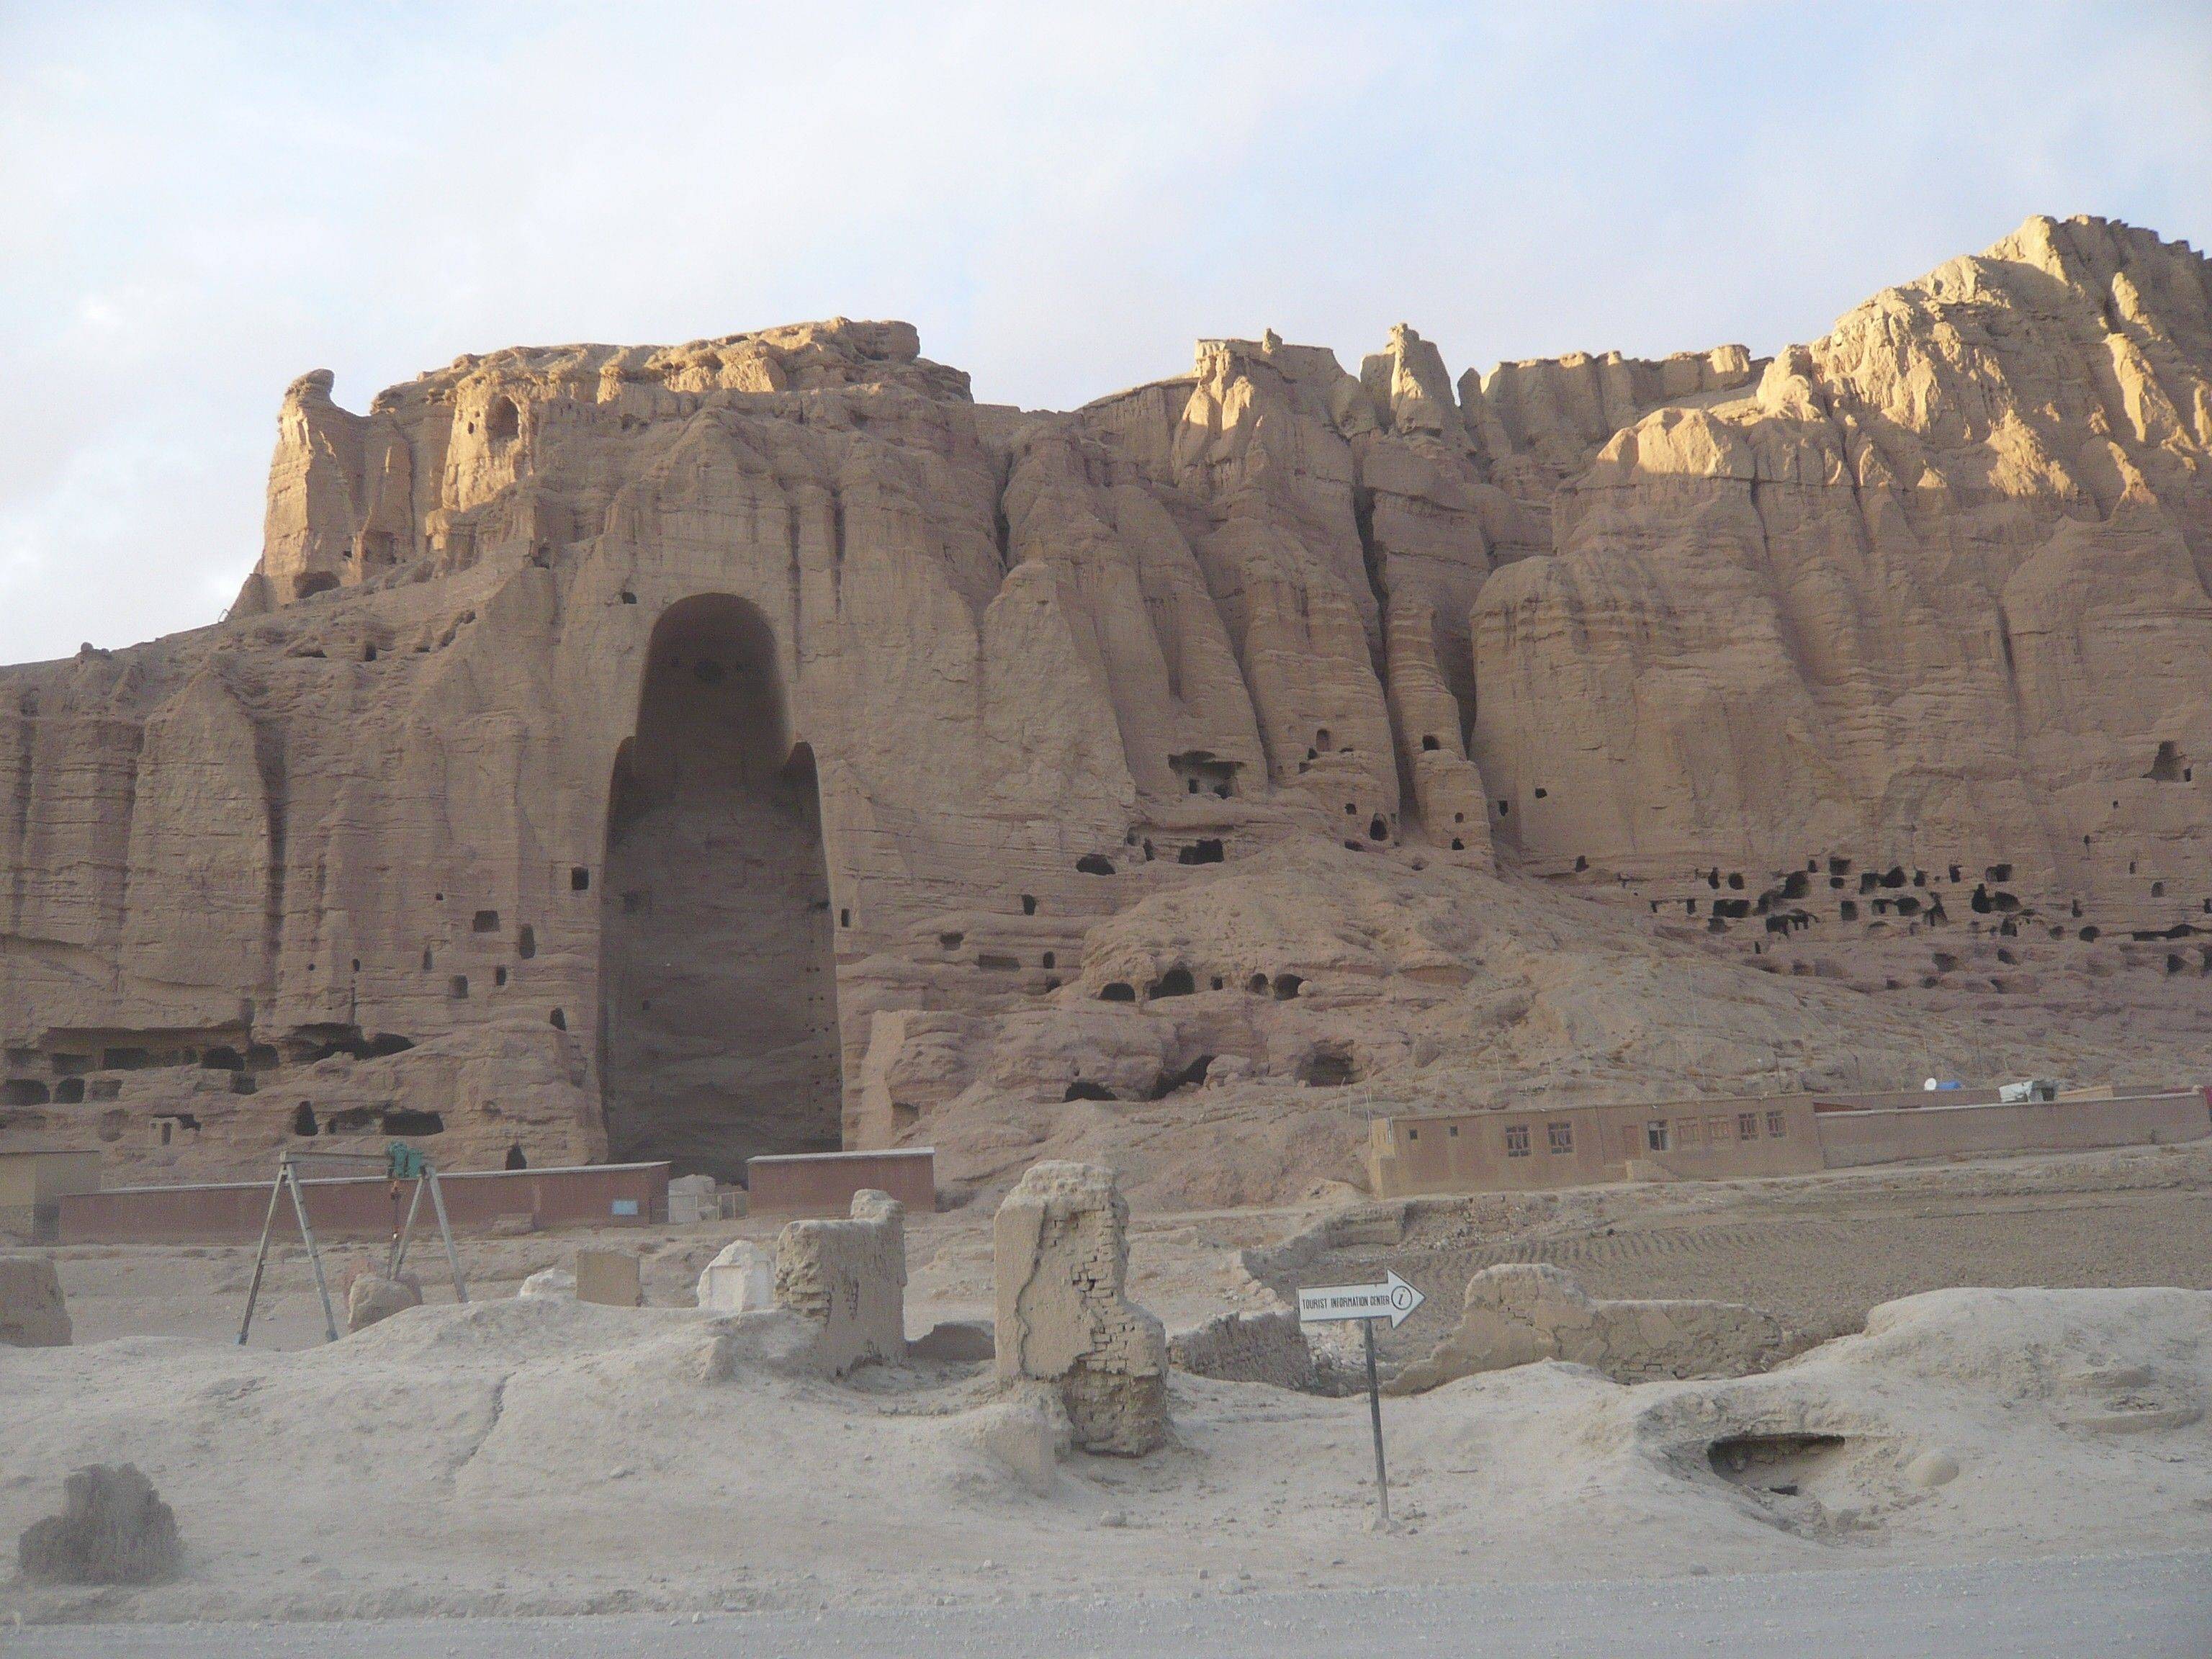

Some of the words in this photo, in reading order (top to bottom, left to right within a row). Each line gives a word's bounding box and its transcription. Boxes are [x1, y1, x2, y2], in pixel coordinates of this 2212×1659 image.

[1303, 1298, 1327, 1310] TOURIST
[1331, 1296, 1368, 1308] INFORMATION
[1370, 1295, 1390, 1306] CENTER
